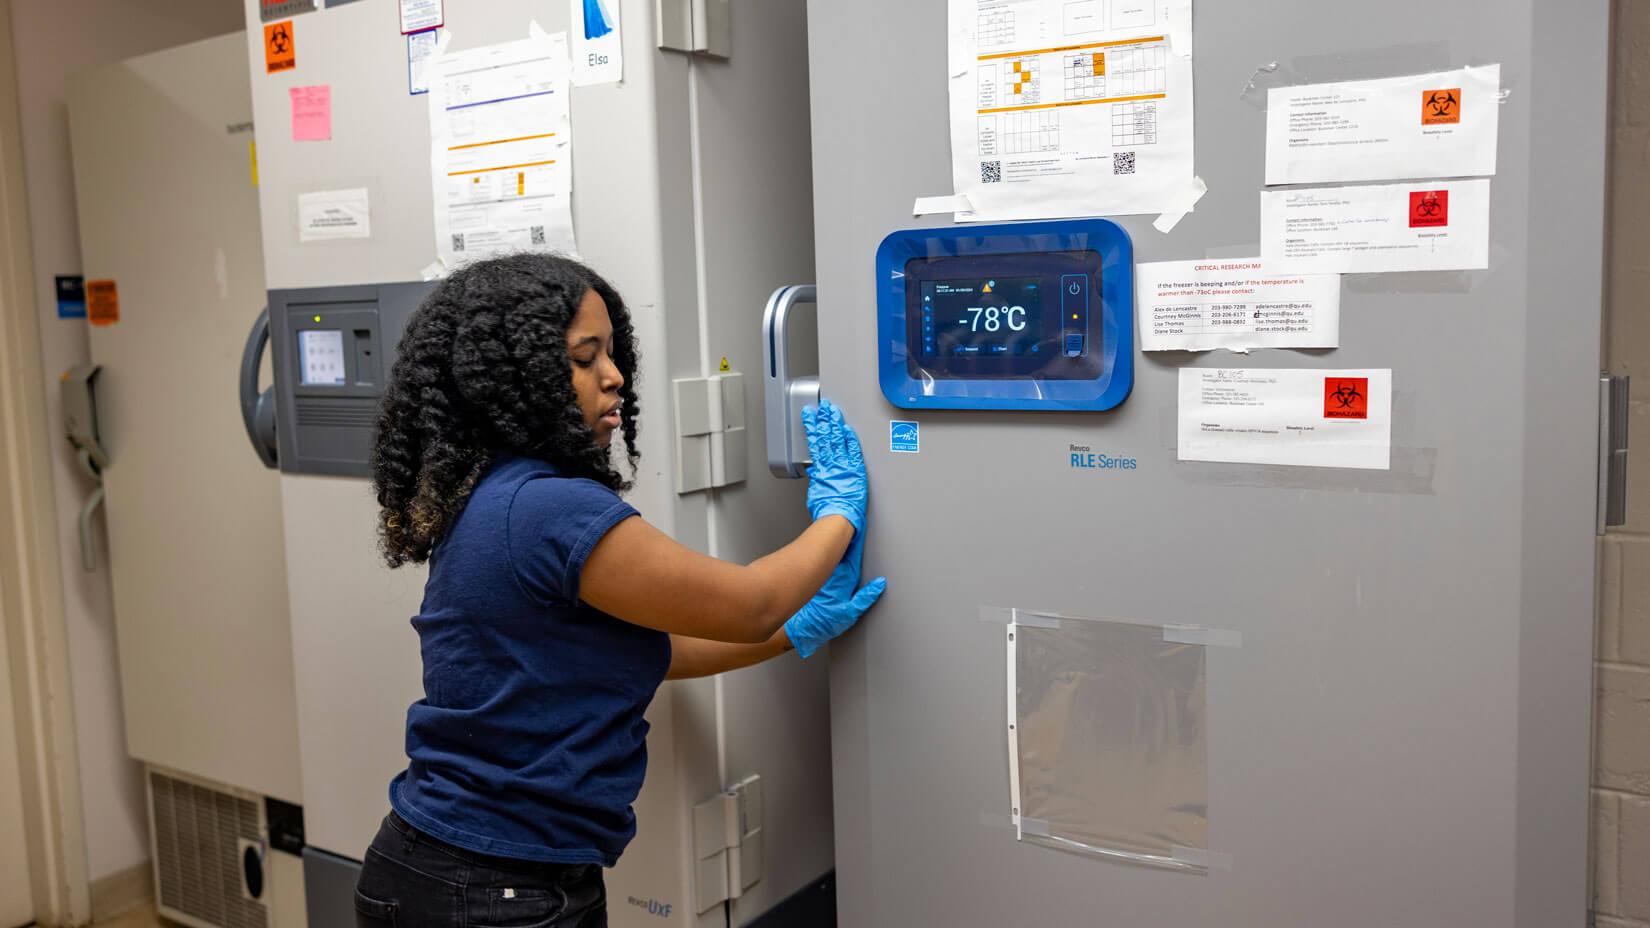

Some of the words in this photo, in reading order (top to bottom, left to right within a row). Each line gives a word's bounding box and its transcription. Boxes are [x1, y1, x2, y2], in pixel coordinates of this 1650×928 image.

[588, 52, 608, 67] Elsa
[1200, 280, 1223, 288] beeping
[1224, 279, 1244, 287] and/or
[1070, 444, 1090, 452] Revco
[1071, 454, 1096, 468] RLE
[1098, 454, 1137, 470] Series
